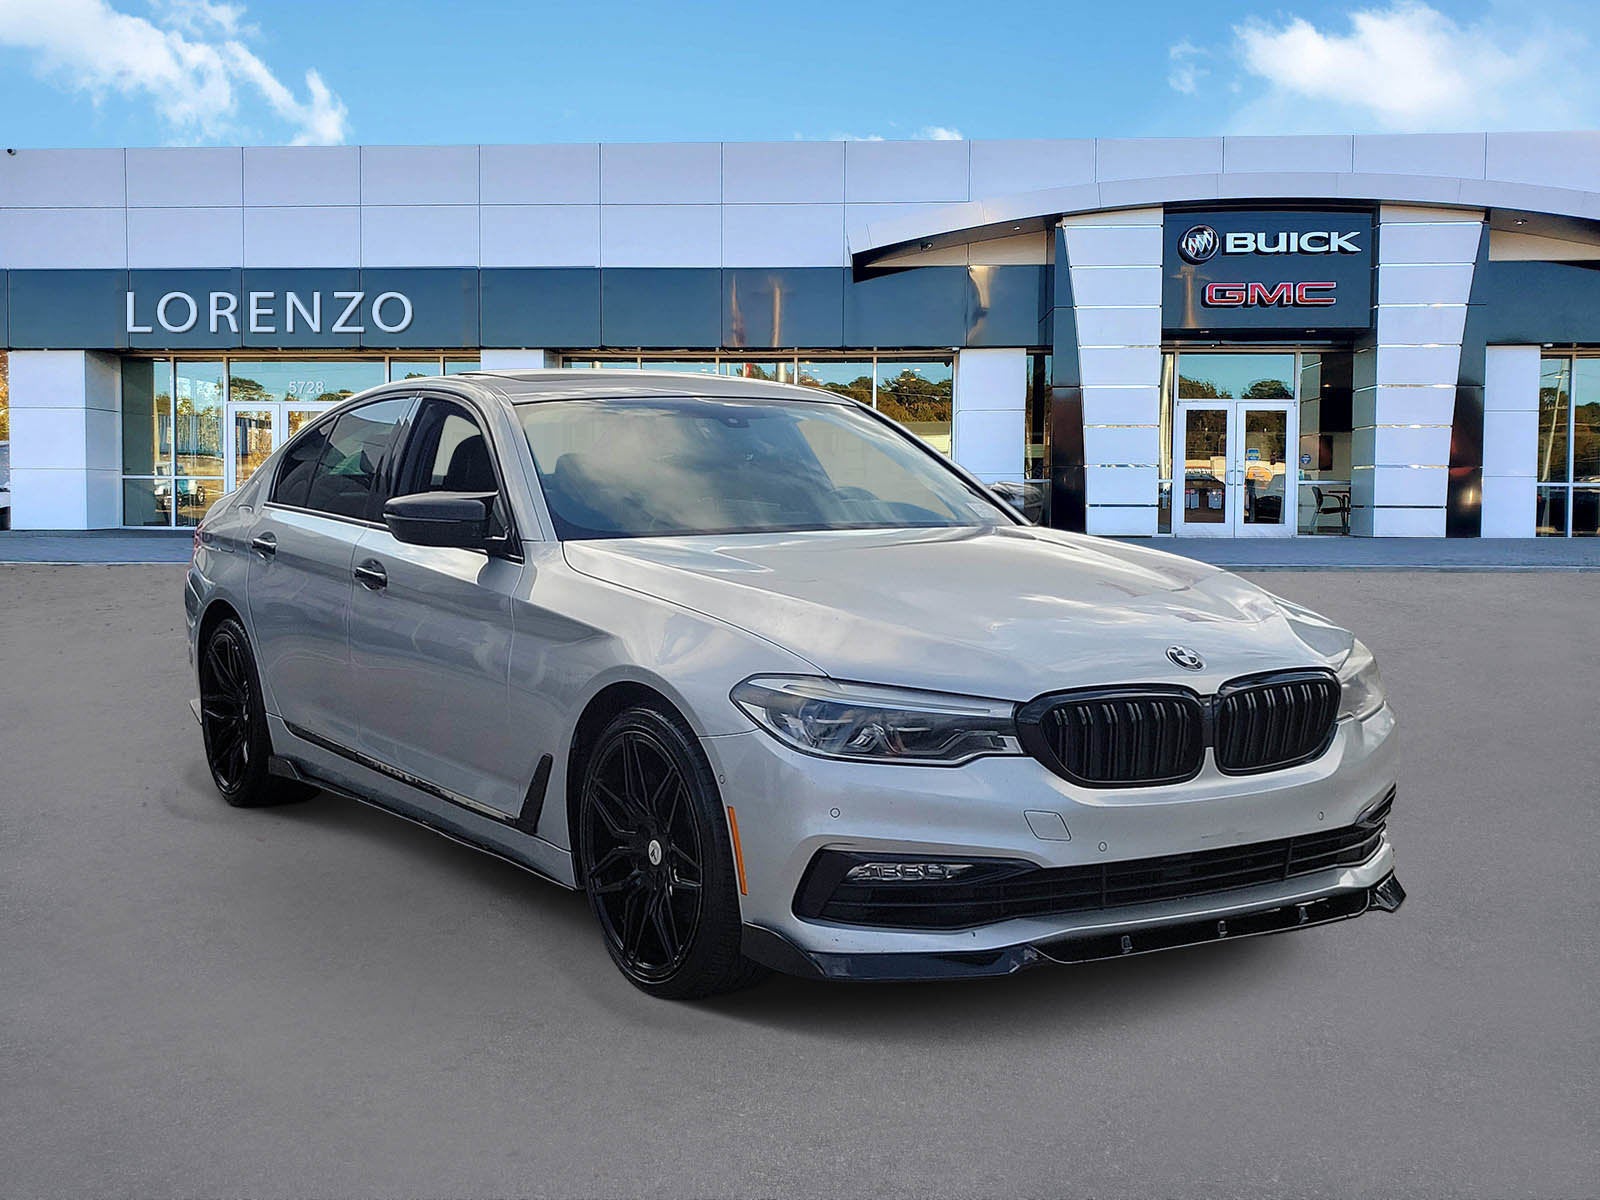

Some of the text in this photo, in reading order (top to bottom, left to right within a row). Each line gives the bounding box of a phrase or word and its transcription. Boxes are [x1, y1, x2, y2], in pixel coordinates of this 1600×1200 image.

[1225, 231, 1362, 253] BUICK
[1206, 281, 1337, 306] GMC
[126, 291, 413, 333] LORENZO
[288, 380, 325, 394] 5728
